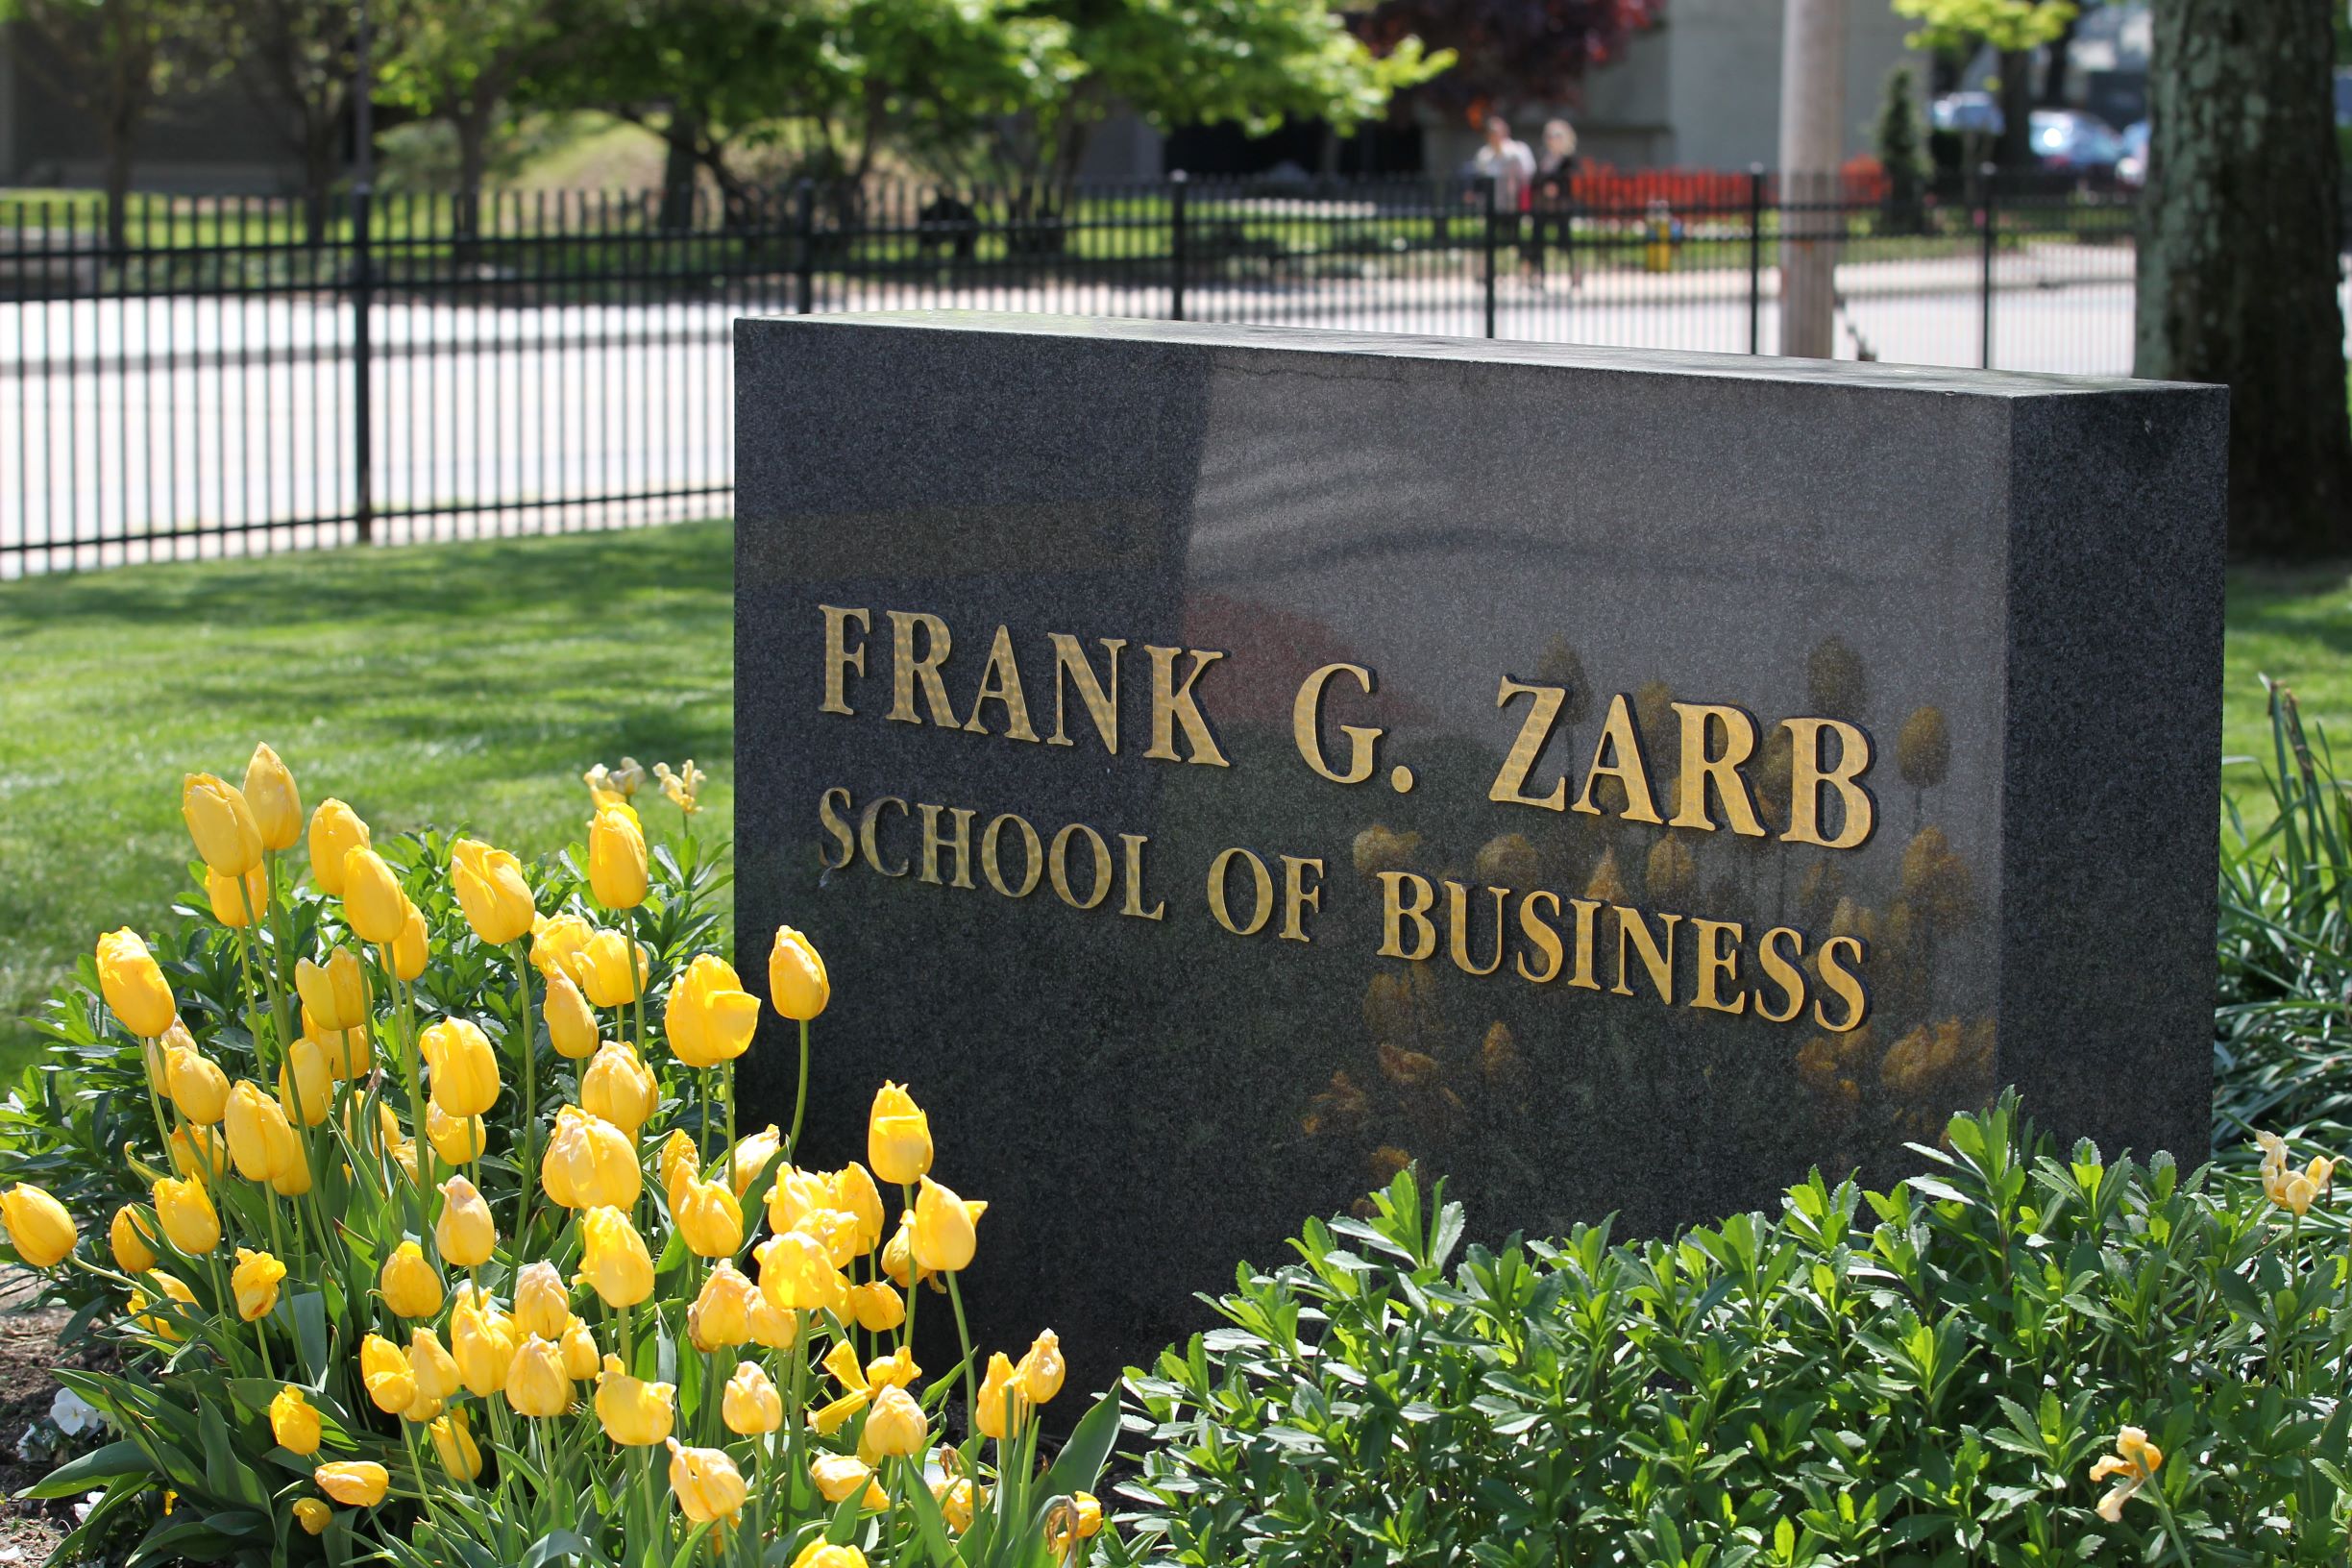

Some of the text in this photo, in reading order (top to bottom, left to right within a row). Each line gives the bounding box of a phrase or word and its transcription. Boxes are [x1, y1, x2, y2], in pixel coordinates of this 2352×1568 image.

[818, 604, 1875, 849] FRANK G. ZARB
[817, 787, 1869, 1034] SCHOOL OF BUSINESS
